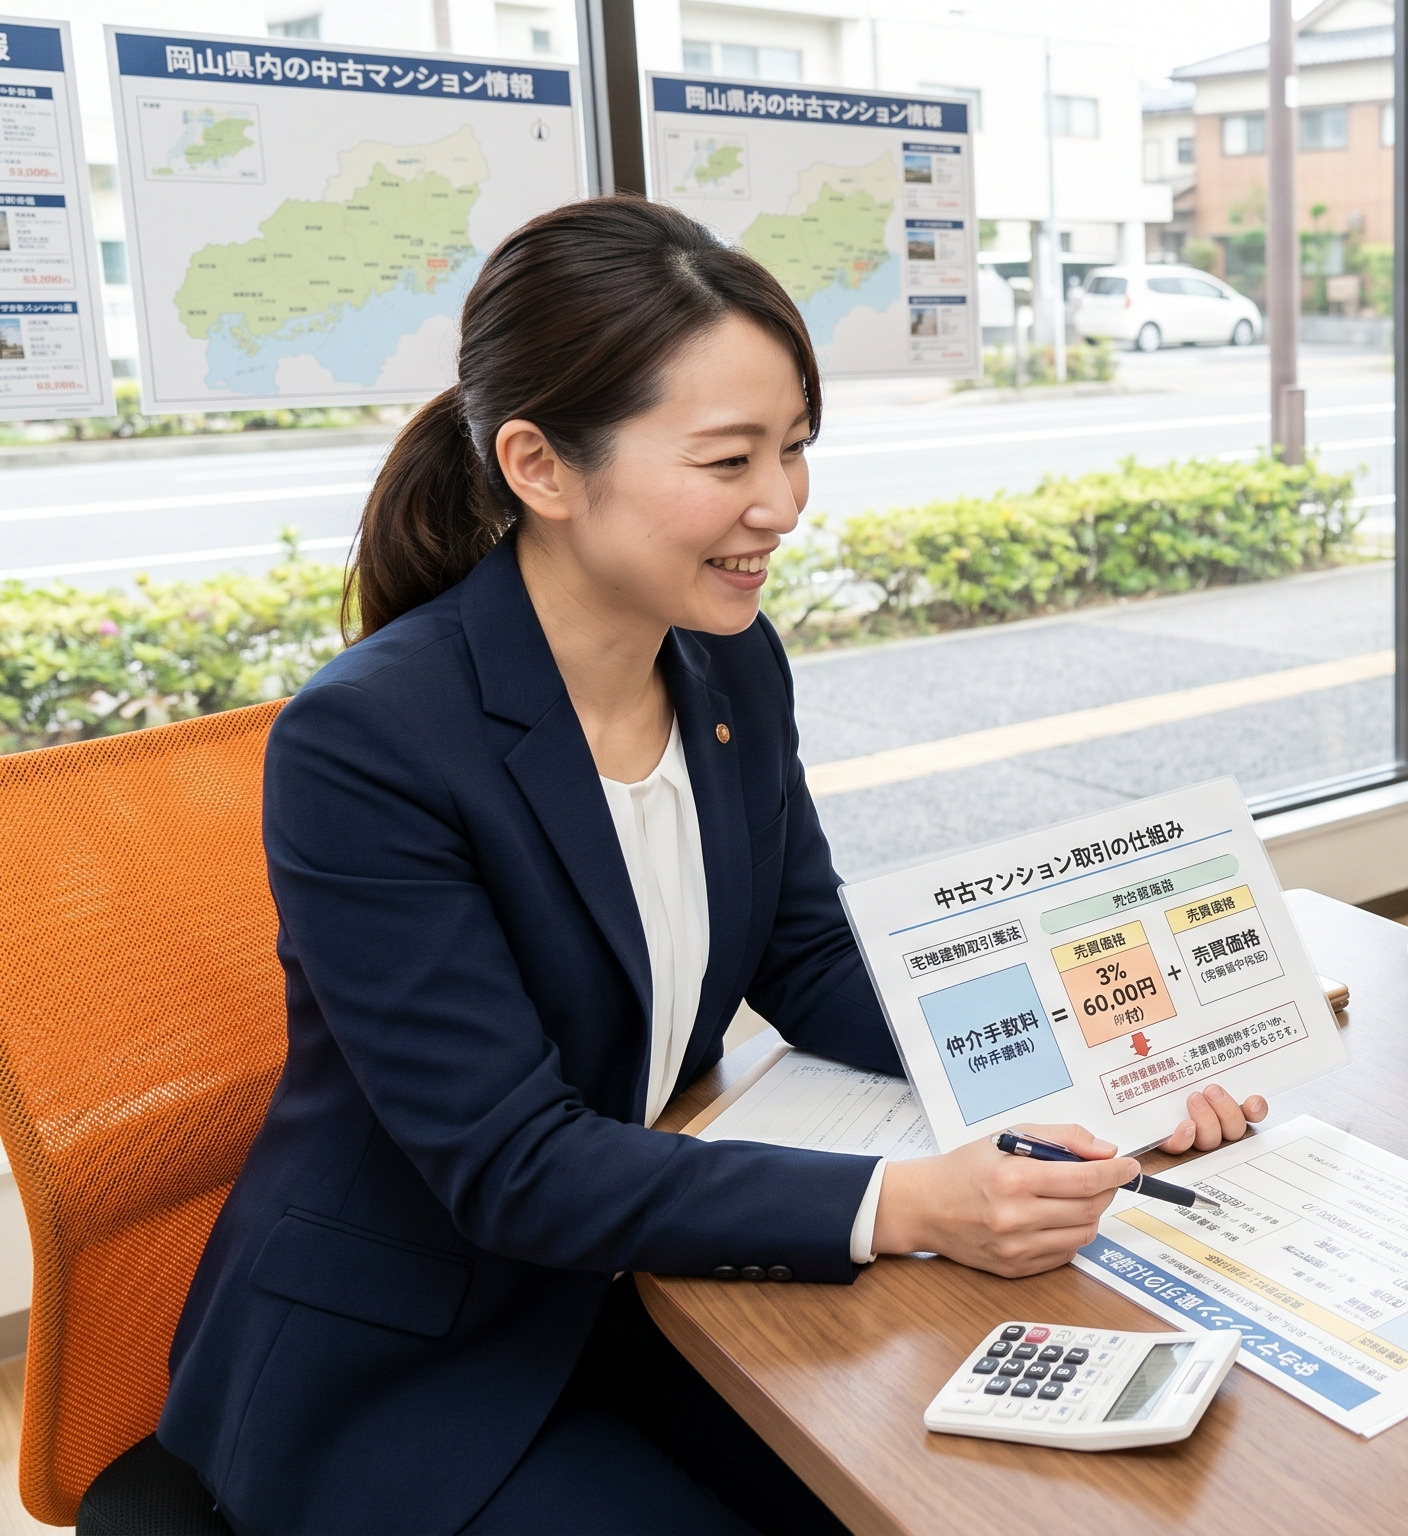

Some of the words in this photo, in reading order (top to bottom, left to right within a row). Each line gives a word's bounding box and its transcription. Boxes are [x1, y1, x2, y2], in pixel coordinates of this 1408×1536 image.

[166, 46, 534, 98] 岡山県内の中古マンション情報
[685, 86, 941, 127] 岡山県内の中古マンション情報
[934, 821, 1184, 908] 中古マンション取引の仕組み
[1192, 929, 1260, 966] 売買価格
[1096, 963, 1126, 985] 3%
[1084, 977, 1156, 1015] 60,00円
[947, 1010, 1038, 1058] 仲介手数料
